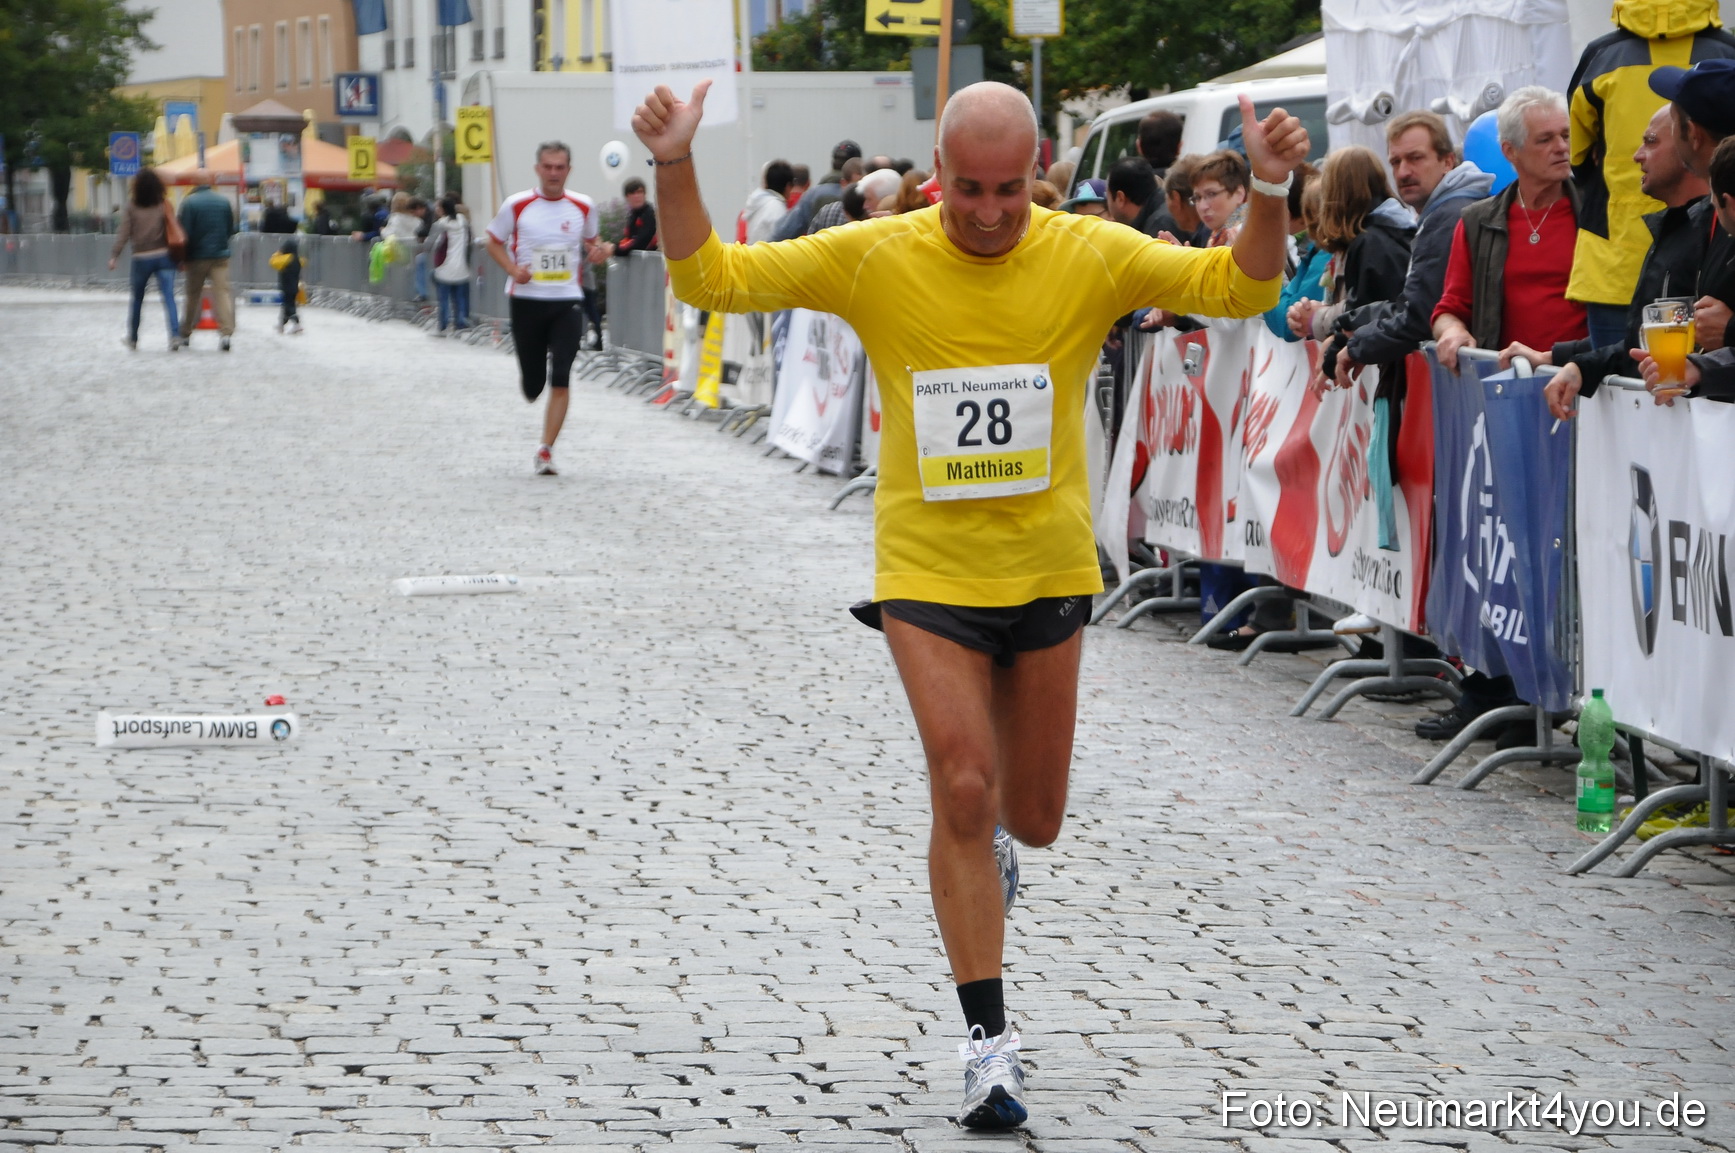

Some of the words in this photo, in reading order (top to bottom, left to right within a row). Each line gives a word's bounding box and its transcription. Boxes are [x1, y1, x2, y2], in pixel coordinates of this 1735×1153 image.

[464, 122, 484, 151] C
[355, 149, 369, 170] D
[541, 255, 566, 269] 514
[916, 382, 957, 396] PARTL
[962, 378, 1027, 392] Neumarkt
[956, 398, 1012, 447] 28
[946, 459, 1023, 480] Matthias
[112, 719, 203, 740] Laufsport
[208, 721, 258, 740] BMW
